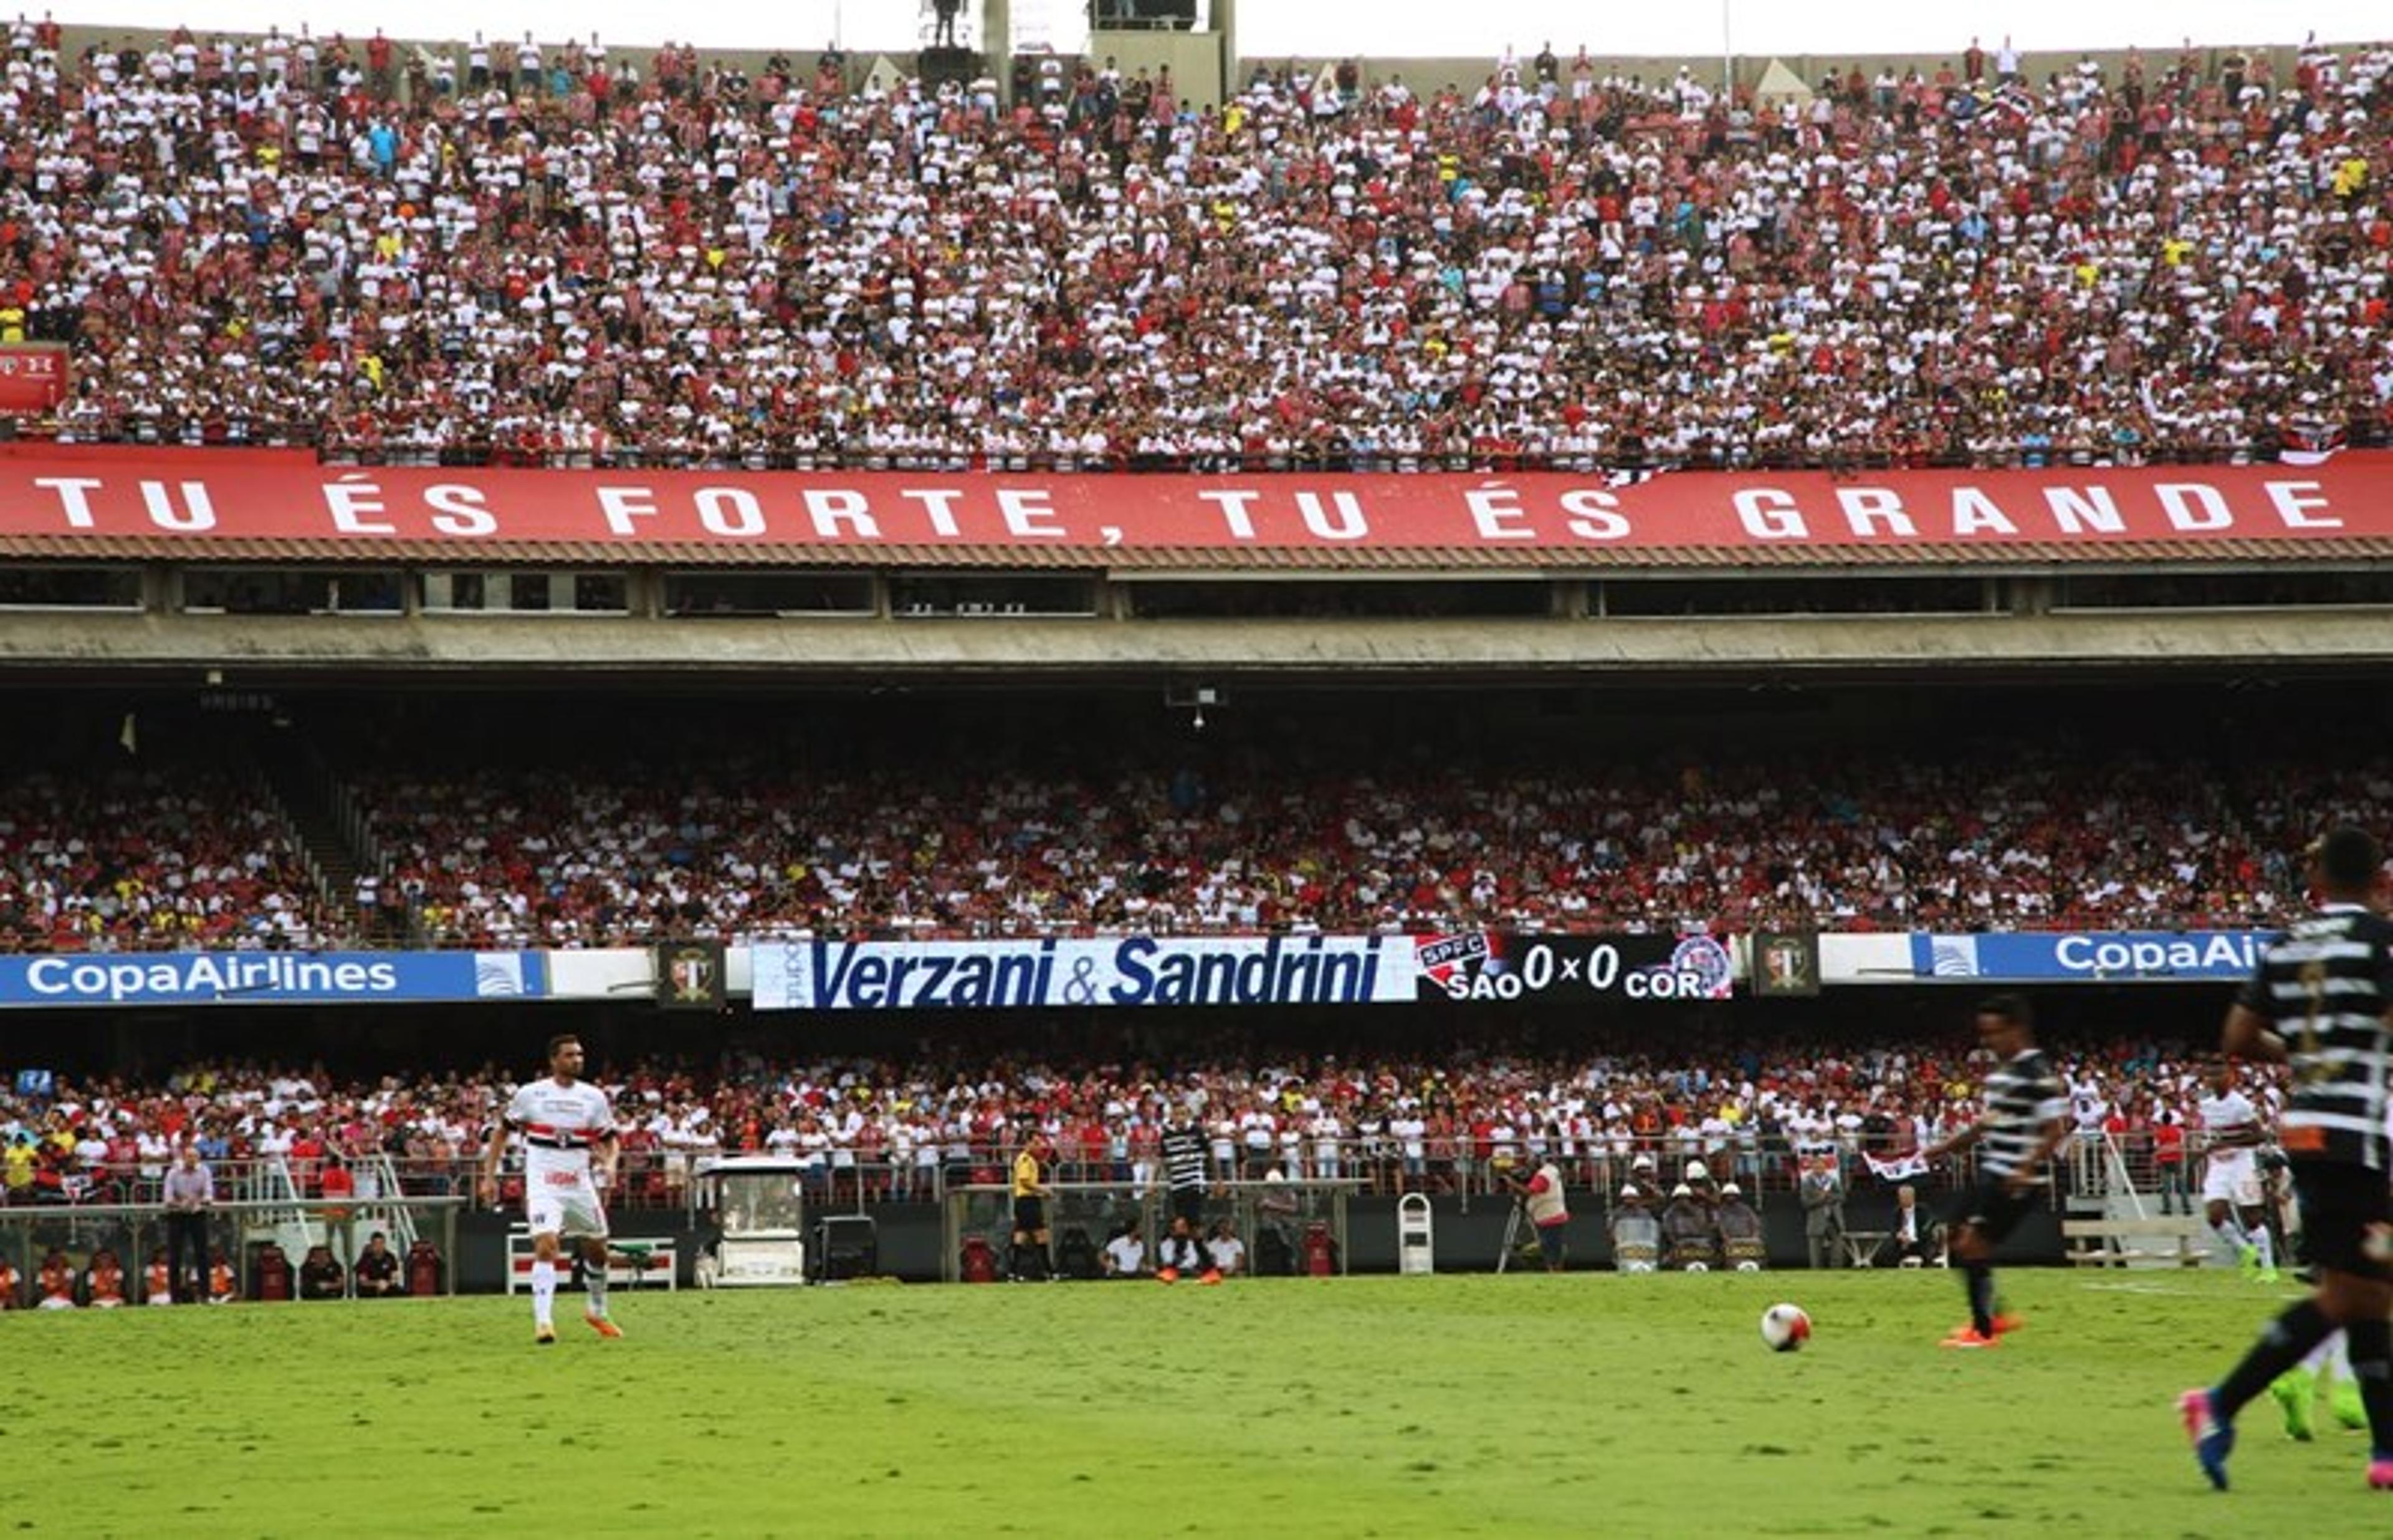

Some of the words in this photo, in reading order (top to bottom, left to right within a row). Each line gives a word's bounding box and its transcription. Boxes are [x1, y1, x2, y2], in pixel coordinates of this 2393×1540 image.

[35, 477, 216, 530] TU
[322, 472, 498, 536] ÉS
[596, 487, 1123, 546] FORTE,
[1198, 490, 1368, 539] TU
[1464, 480, 1631, 539] ÉS
[1732, 481, 2343, 538] GRANDE
[811, 938, 1057, 1008] Verzani
[1063, 955, 1099, 1006] &
[1109, 936, 1382, 1005] Sandrini
[1422, 934, 1482, 964] SPFC
[1523, 943, 1554, 991] 0
[1587, 943, 1619, 991] 0
[1624, 971, 1701, 998] COR
